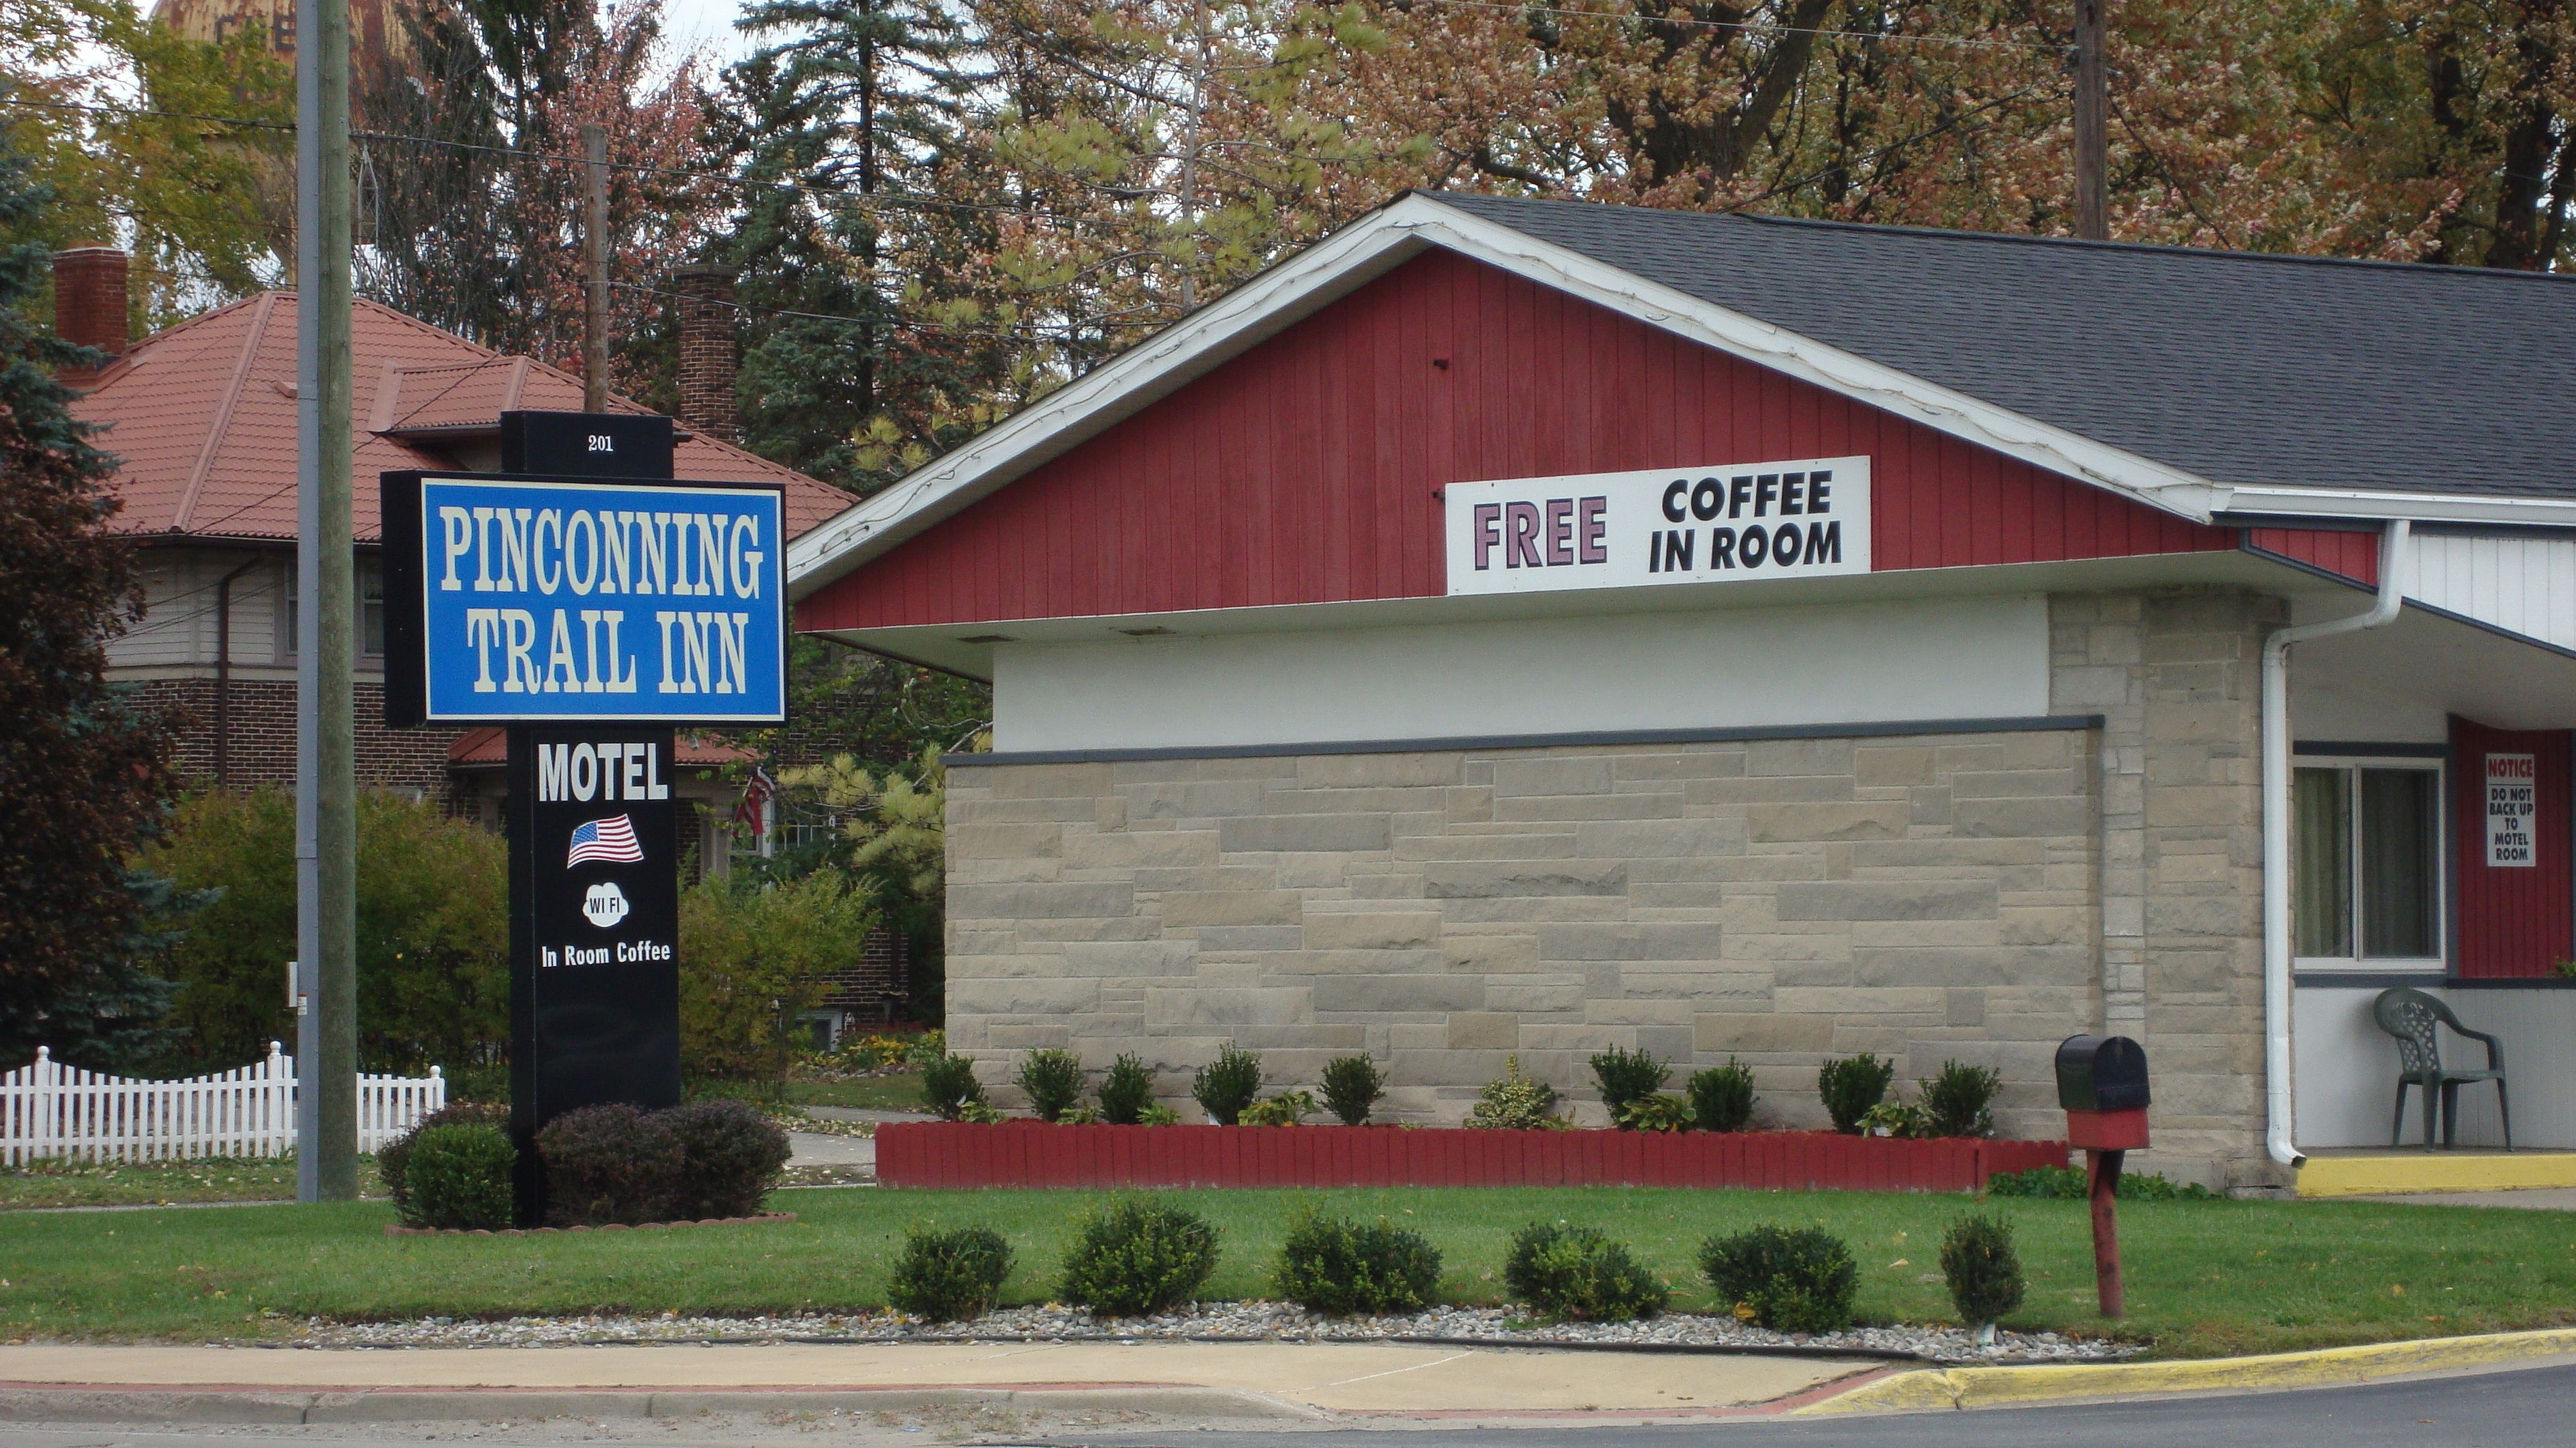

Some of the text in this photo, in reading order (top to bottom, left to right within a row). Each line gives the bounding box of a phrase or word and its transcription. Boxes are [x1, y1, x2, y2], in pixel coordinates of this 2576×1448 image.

[588, 435, 614, 452] 201
[1662, 470, 1832, 523] COFFEE
[1474, 495, 1607, 572] FREE
[439, 506, 763, 599] PINCONNING
[1649, 520, 1841, 573] IN ROOM
[467, 608, 749, 694] TRAIL INN
[538, 742, 668, 802] MOTEL
[2487, 758, 2532, 778] NOTICE
[2491, 788, 2532, 801] DO NOT
[2489, 803, 2533, 815] BACK UP
[2505, 818, 2518, 830] TO
[2495, 833, 2528, 845] MOTEL
[2496, 847, 2528, 860] ROOM
[542, 940, 671, 967] In Room Coffee
